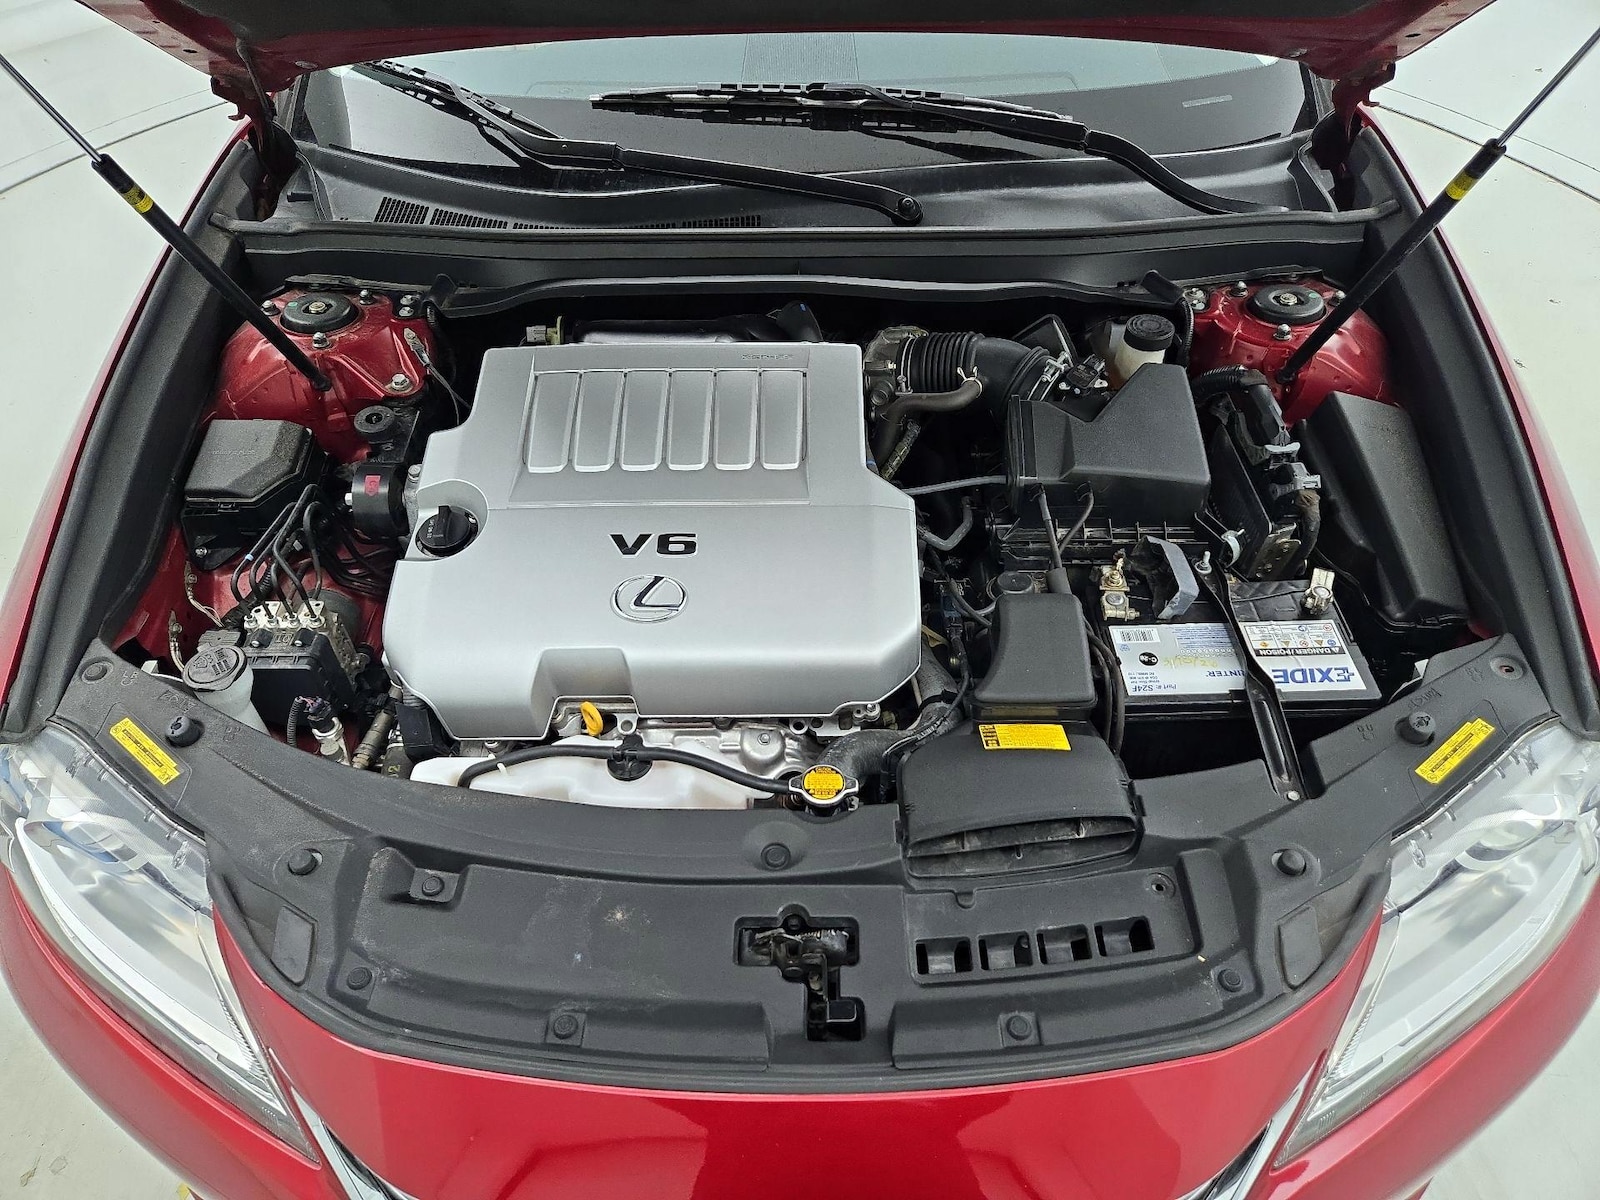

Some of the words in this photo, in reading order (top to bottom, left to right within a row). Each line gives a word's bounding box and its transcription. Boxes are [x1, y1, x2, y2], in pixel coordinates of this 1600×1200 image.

[608, 533, 697, 555] V6
[1271, 667, 1354, 684] EXIDE
[1132, 682, 1153, 692] S24F
[1163, 683, 1177, 691] Part
